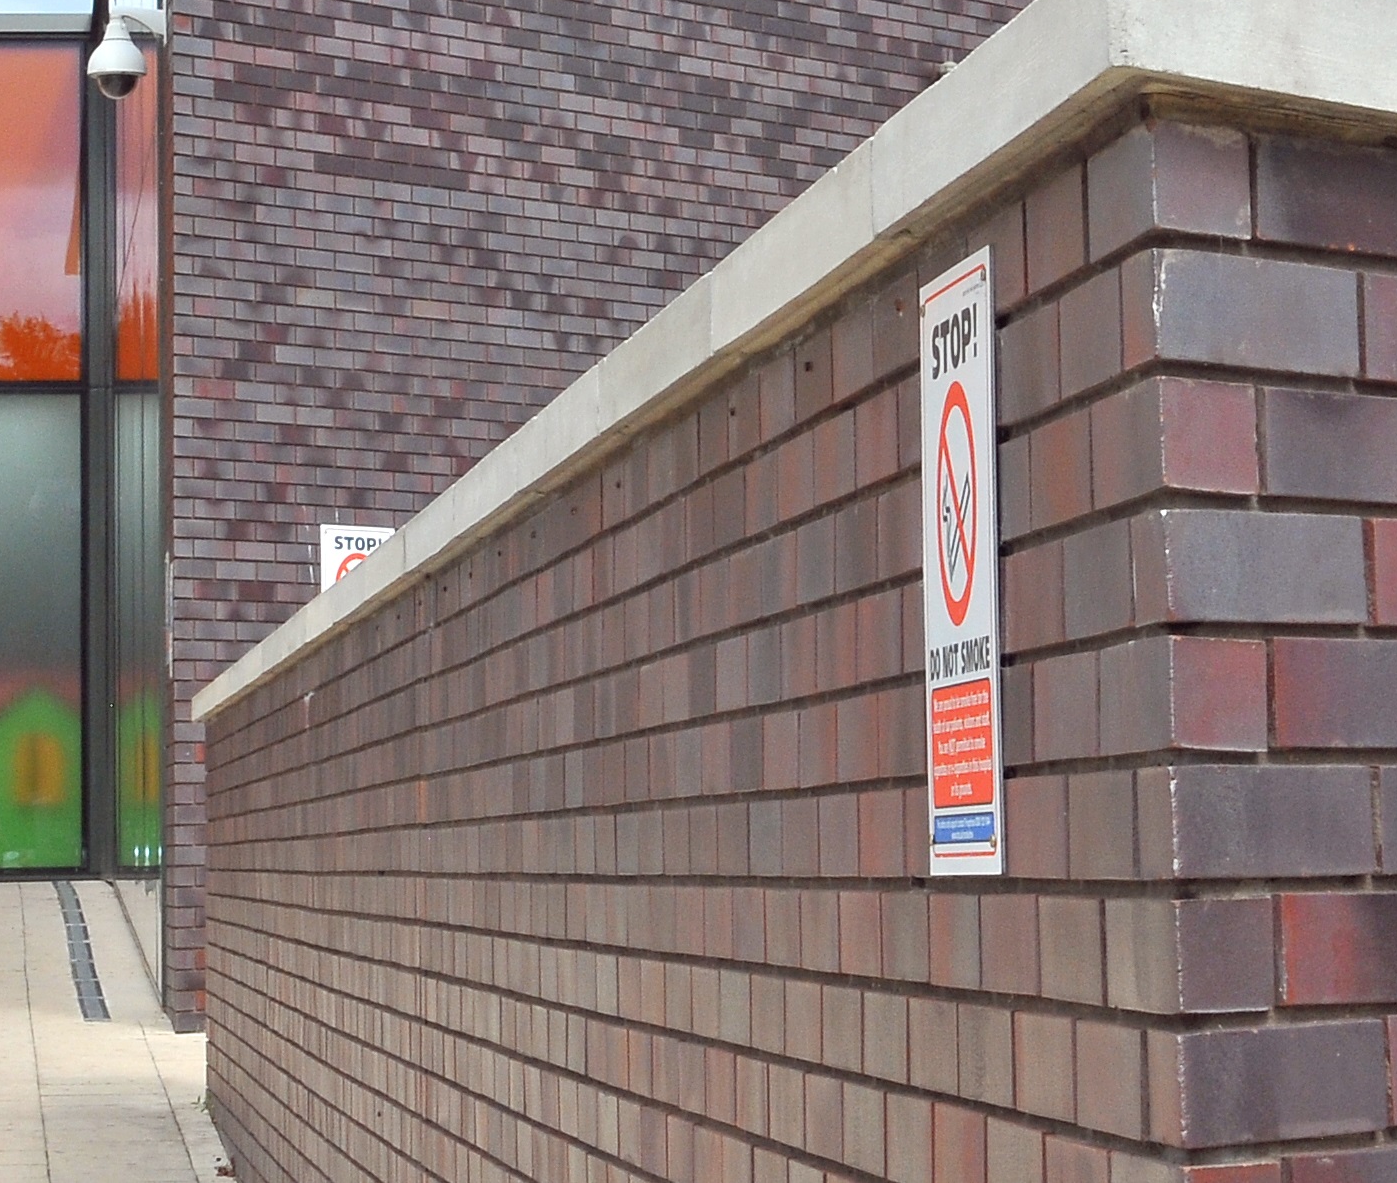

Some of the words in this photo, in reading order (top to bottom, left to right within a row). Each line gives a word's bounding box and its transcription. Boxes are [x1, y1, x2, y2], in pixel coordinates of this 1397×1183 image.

[931, 302, 978, 380] STOP!
[930, 649, 941, 681] DO
[942, 643, 959, 679] NOT
[961, 635, 990, 675] SMOKE
